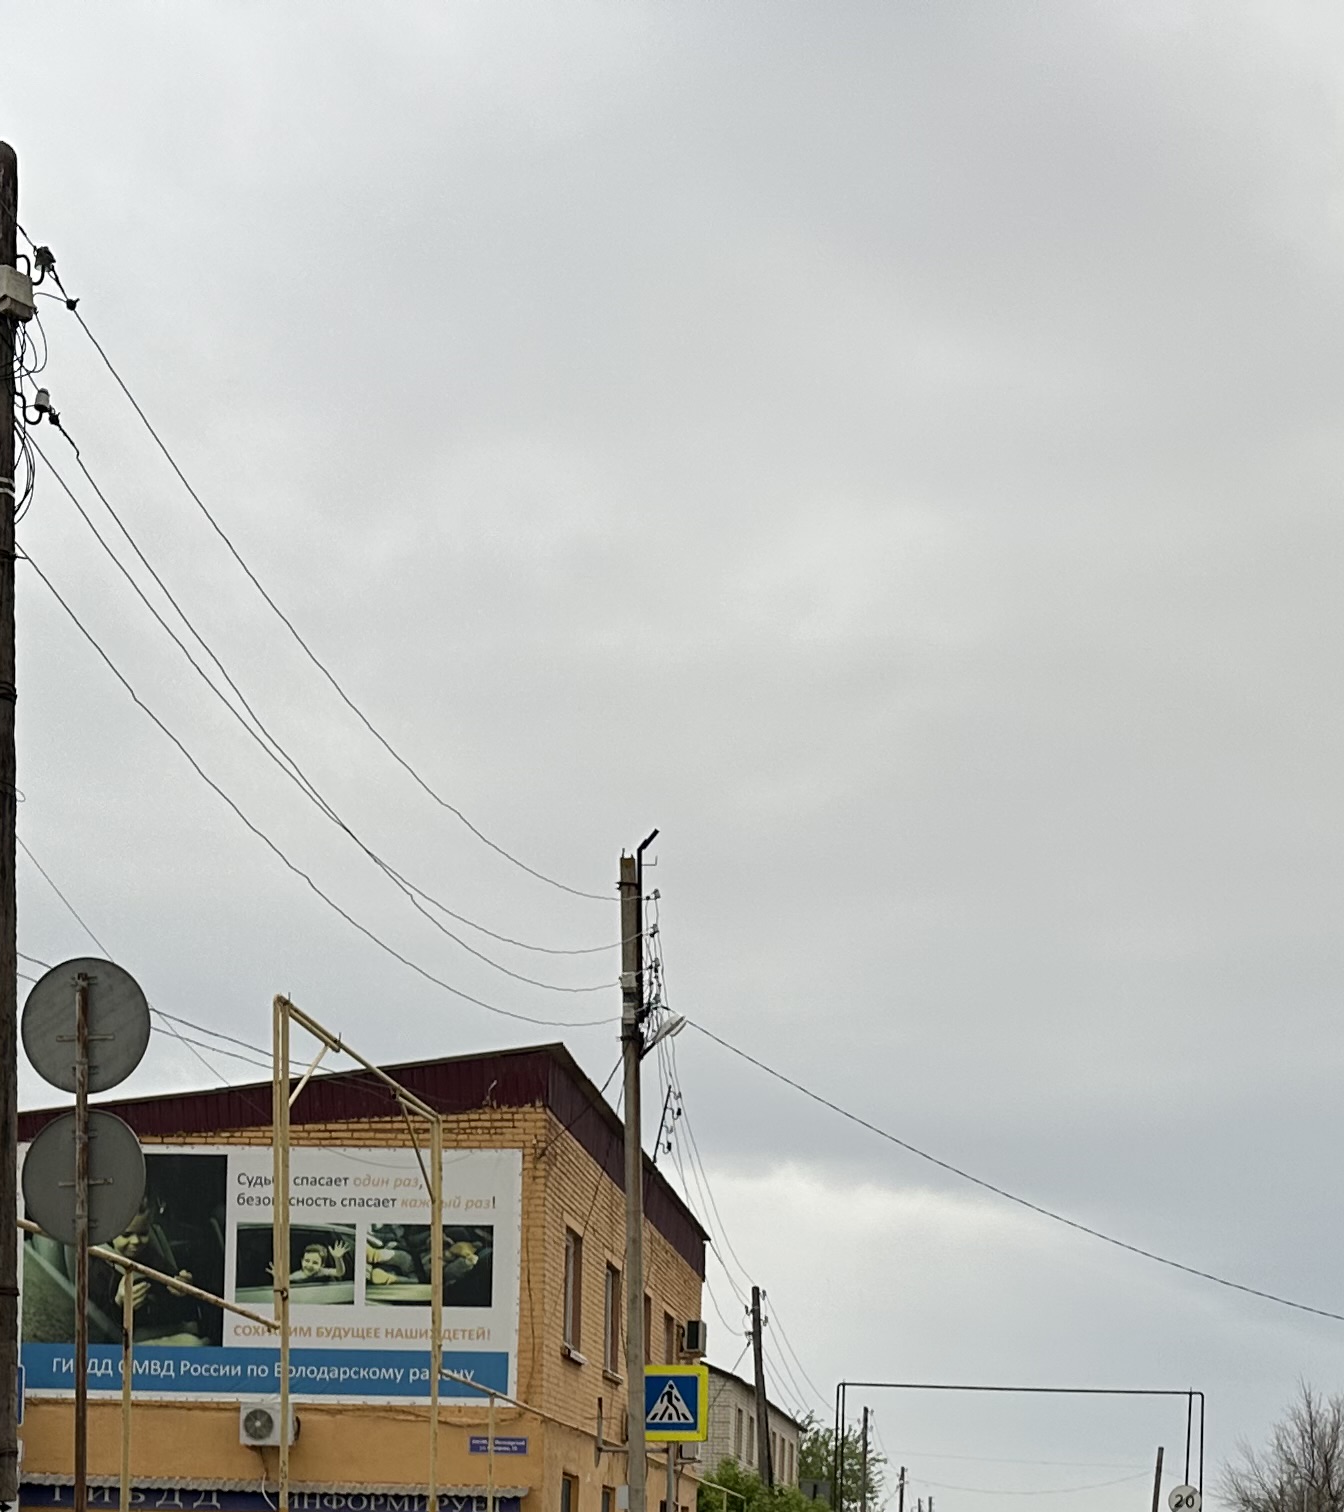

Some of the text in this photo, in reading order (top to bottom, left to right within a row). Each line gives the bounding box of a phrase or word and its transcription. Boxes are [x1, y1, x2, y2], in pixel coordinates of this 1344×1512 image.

[237, 1172, 423, 1190] Судь спасает один раз,
[236, 1192, 496, 1211] безосность спасает кажый раз!
[233, 1325, 312, 1338] СОХРАИМ
[316, 1327, 380, 1341] БУДУЩЕЕ
[442, 1327, 491, 1342] ДЕТЕЙ!
[53, 1357, 114, 1378] ГИДД
[180, 1360, 242, 1377] России
[247, 1364, 269, 1378] по
[274, 1361, 405, 1384] Володарскому
[409, 1367, 475, 1384] раону
[1174, 1494, 1195, 1508] 20
